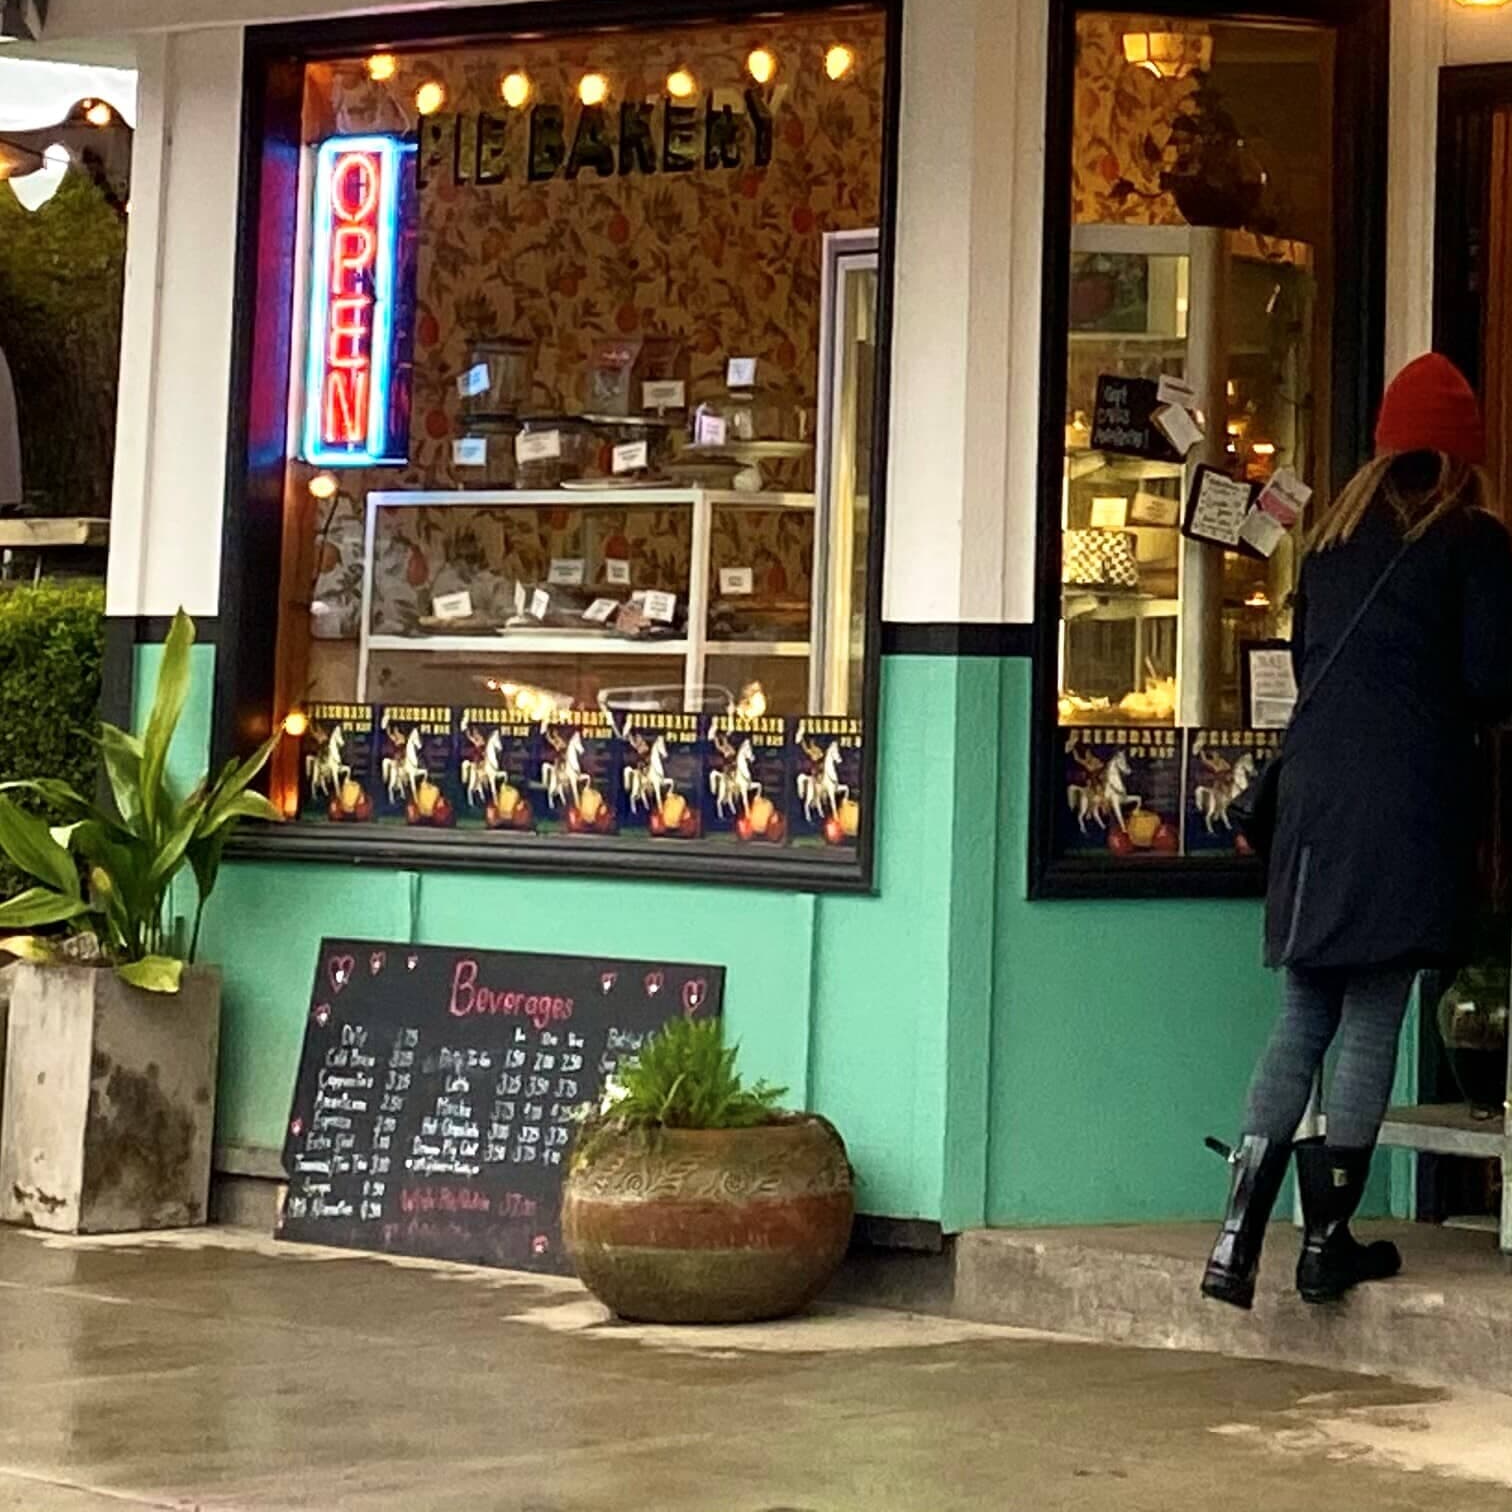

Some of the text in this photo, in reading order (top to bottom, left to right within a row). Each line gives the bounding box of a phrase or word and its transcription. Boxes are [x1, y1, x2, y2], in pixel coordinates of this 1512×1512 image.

[415, 85, 786, 186] PIE BAKERY
[326, 151, 378, 443] OPEN
[449, 960, 575, 1029] Beverages
